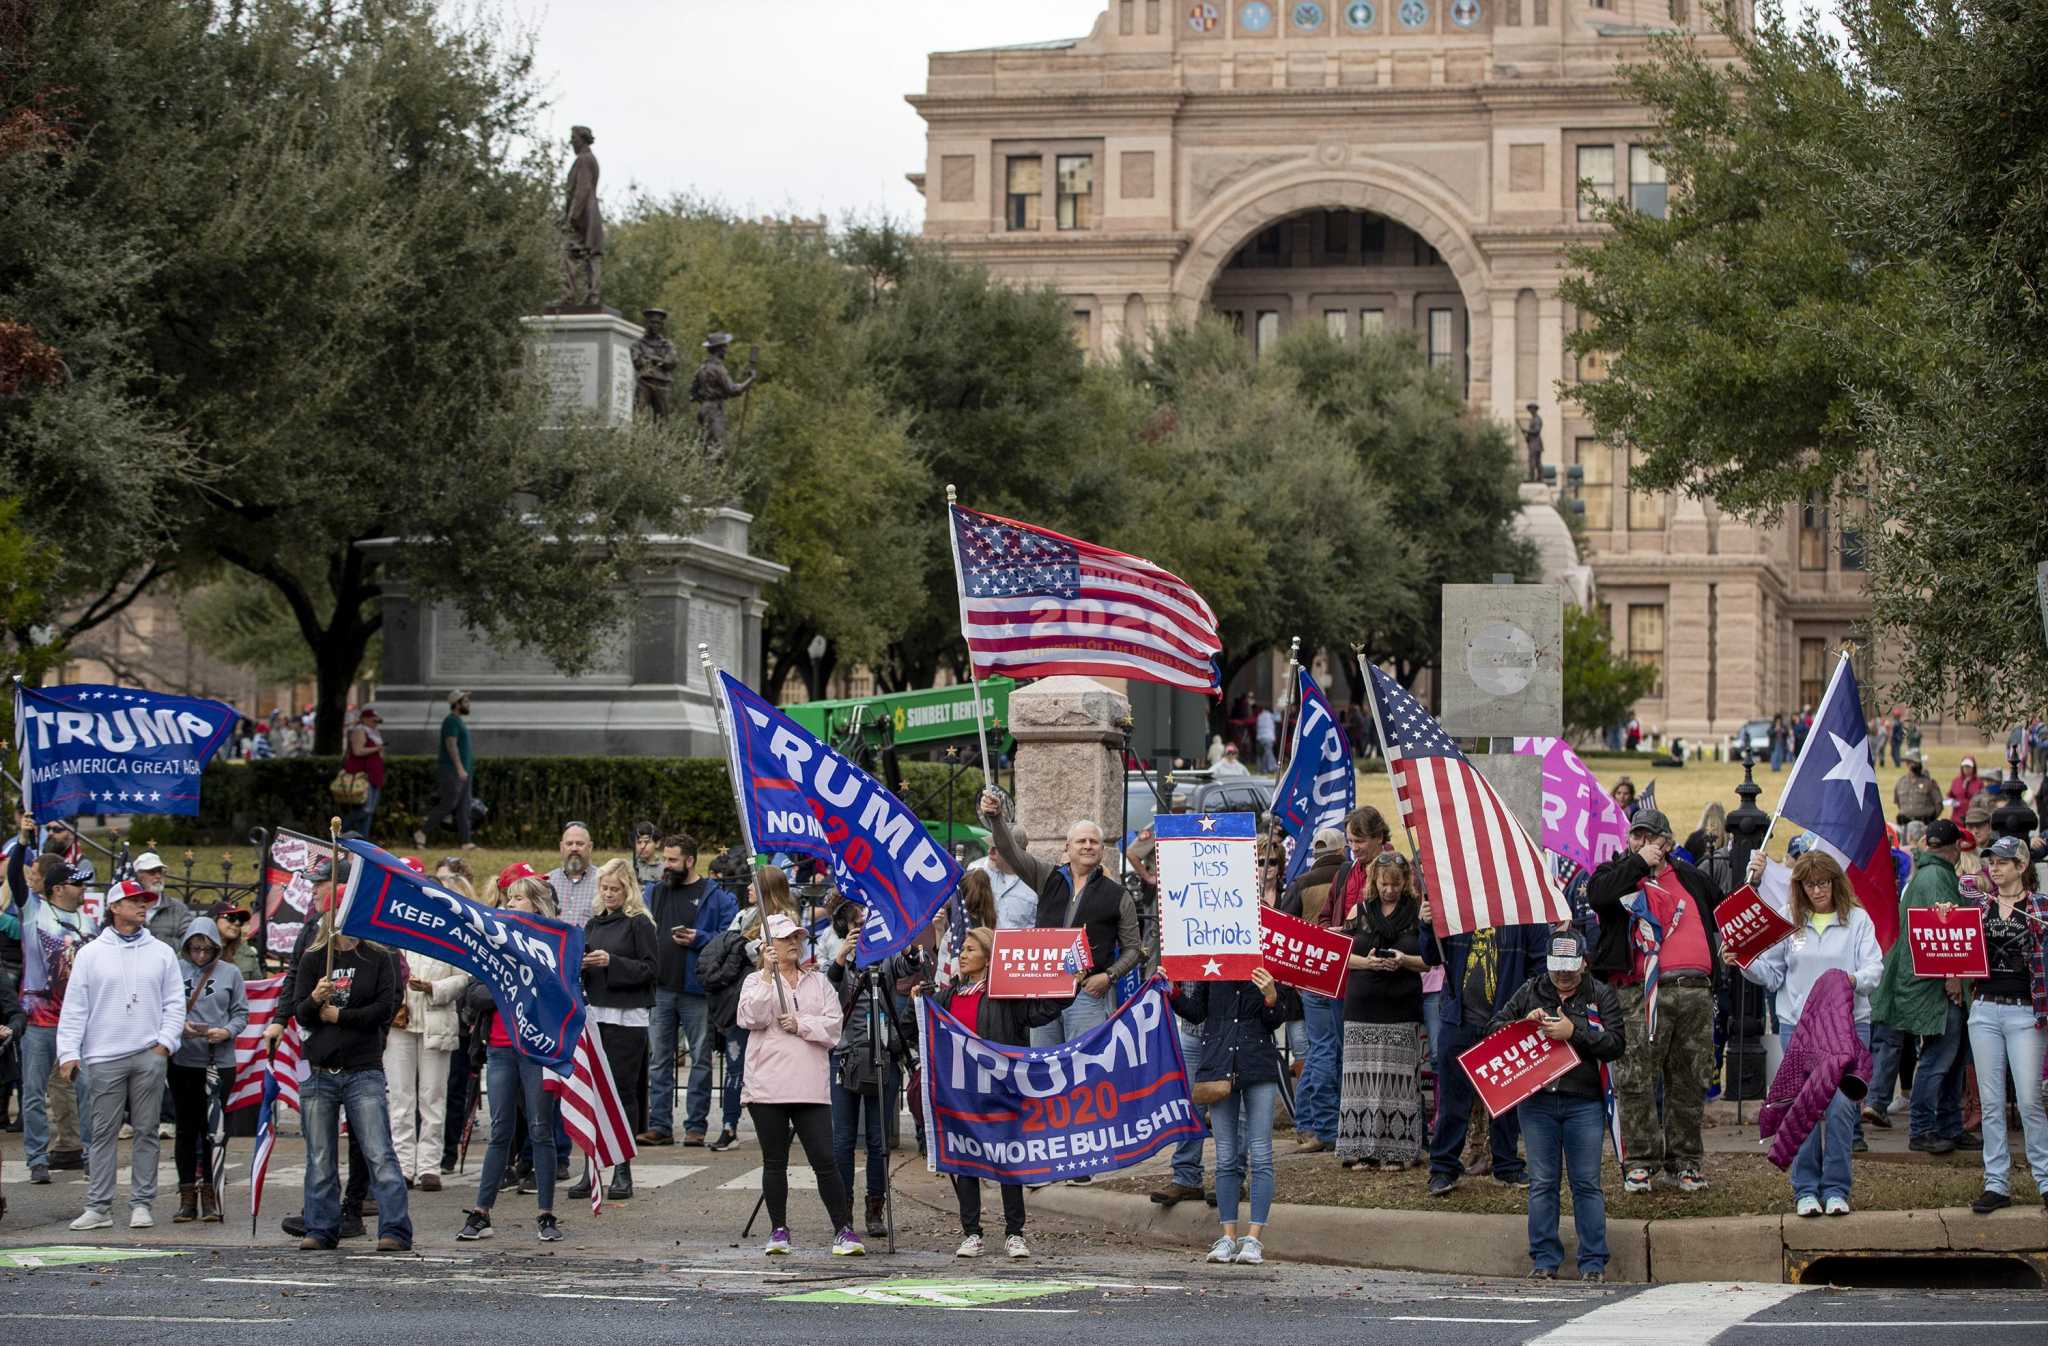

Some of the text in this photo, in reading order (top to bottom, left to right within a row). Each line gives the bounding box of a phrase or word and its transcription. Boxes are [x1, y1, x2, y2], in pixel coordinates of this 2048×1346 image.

[907, 697, 994, 728] SUNBELT RENTLS
[25, 704, 214, 753] TRUMP
[63, 758, 128, 775] AMERICA
[131, 759, 180, 775] GREAT
[1191, 842, 1229, 858] DONT
[1194, 861, 1229, 877] MESS
[1190, 882, 1243, 912] TEXAS
[389, 899, 447, 929] KEEP
[1721, 902, 1762, 939] TRUMP
[1182, 917, 1252, 947] Patriots
[1260, 926, 1341, 963] TRUMP
[1727, 915, 1769, 947] PENCE
[1912, 928, 1977, 941] TRUMP
[1262, 942, 1330, 972] PENCE
[1920, 942, 1973, 951] PENCE
[448, 926, 519, 1001] AMERICA
[1004, 962, 1065, 971] PENCE
[939, 988, 1162, 1098] TRUMP
[1489, 1041, 1552, 1085] PENCE
[1020, 1081, 1119, 1133] 2020
[947, 1099, 1193, 1164] NO MORE BULLSHIT
